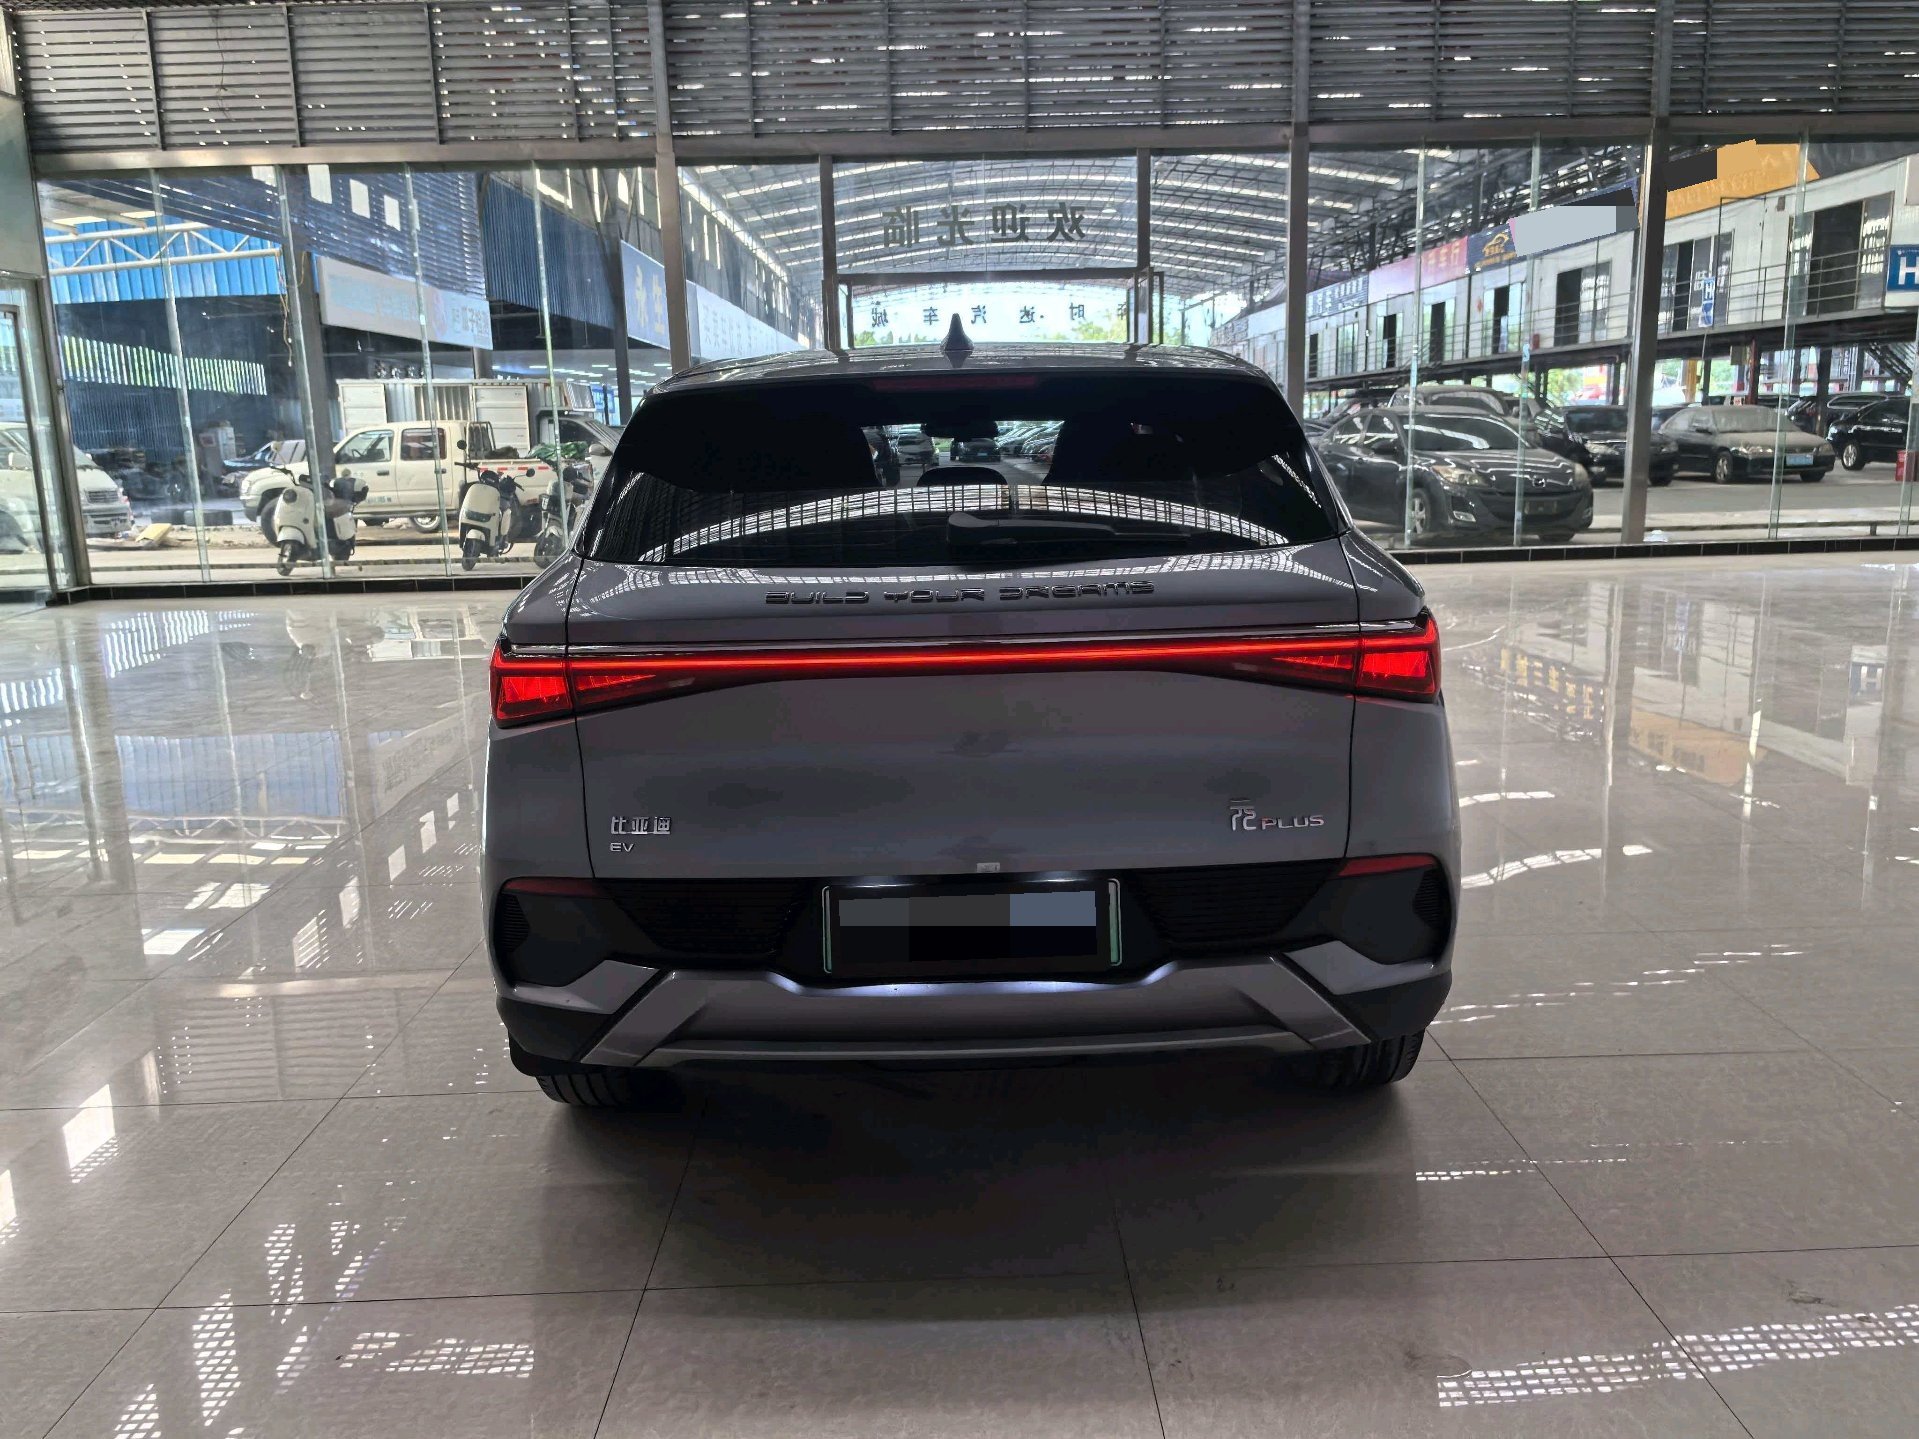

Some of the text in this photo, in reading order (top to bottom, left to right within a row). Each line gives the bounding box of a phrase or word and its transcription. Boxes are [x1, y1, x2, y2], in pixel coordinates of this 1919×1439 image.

[765, 580, 1155, 604] BUILD YOUR DREAMS
[610, 816, 671, 834] 比亚迪
[610, 842, 634, 852] EV
